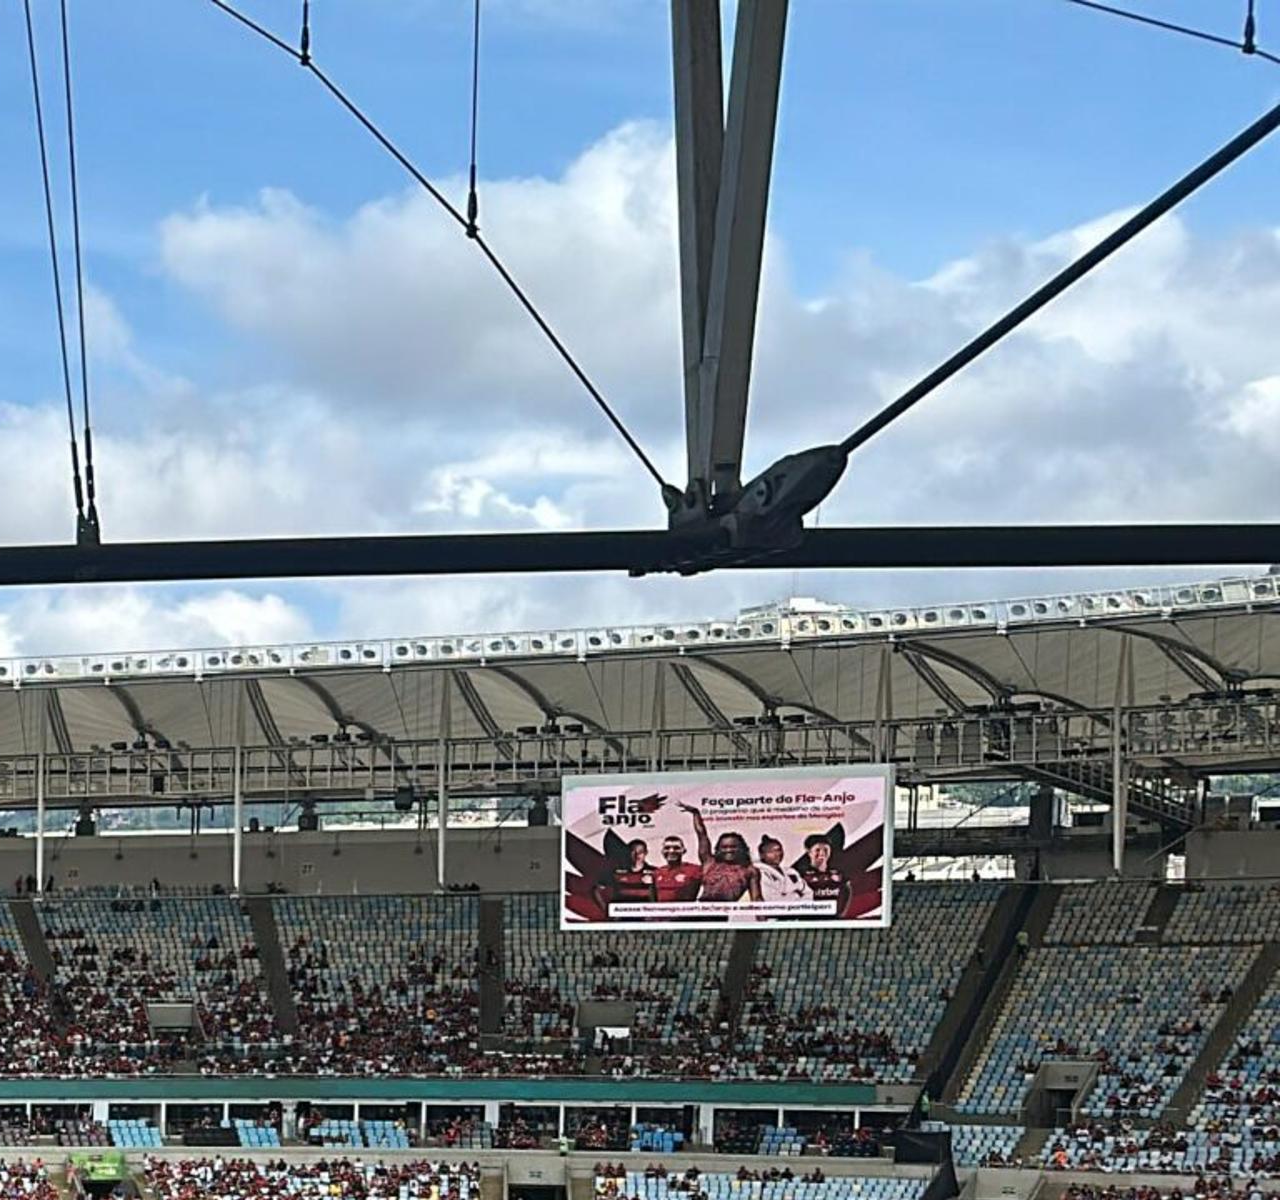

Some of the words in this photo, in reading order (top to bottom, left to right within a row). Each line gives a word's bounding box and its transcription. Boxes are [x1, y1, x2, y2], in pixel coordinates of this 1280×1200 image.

[598, 796, 641, 814] Fla
[701, 797, 734, 807] Faça
[736, 797, 772, 807] parte
[601, 813, 653, 828] anjo
